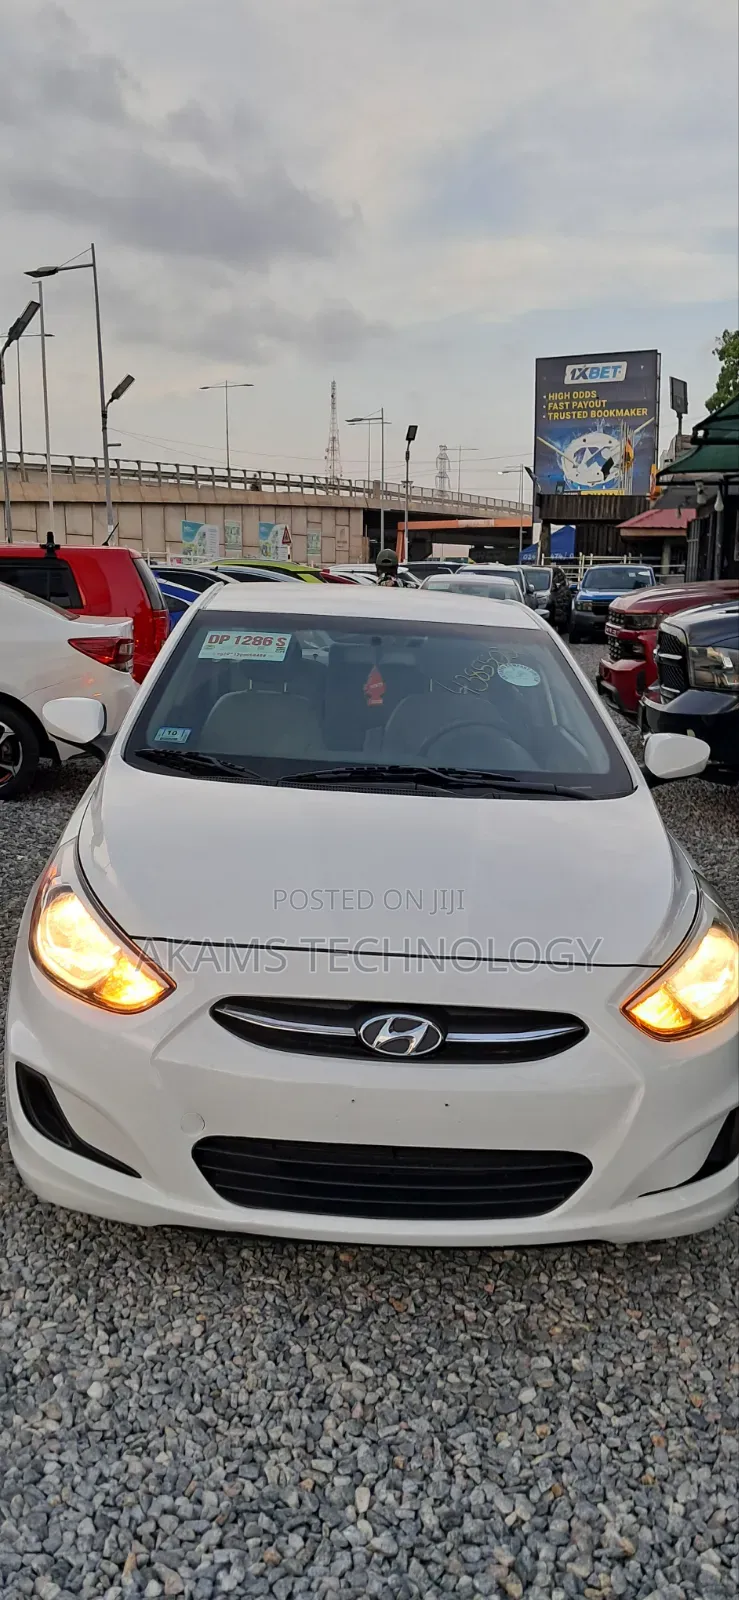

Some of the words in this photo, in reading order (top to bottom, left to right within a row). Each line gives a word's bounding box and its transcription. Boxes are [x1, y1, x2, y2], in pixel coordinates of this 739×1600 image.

[570, 365, 622, 380] 1XBET
[548, 392, 570, 401] HIGH
[572, 390, 597, 399] ODDS
[548, 401, 570, 411] FAST
[572, 399, 608, 409] PAYOUT
[548, 410, 588, 421] TRUSTED
[590, 408, 648, 418] BOOKMAKER
[207, 634, 231, 646] DP
[234, 636, 274, 647] 1286
[275, 637, 288, 648] S
